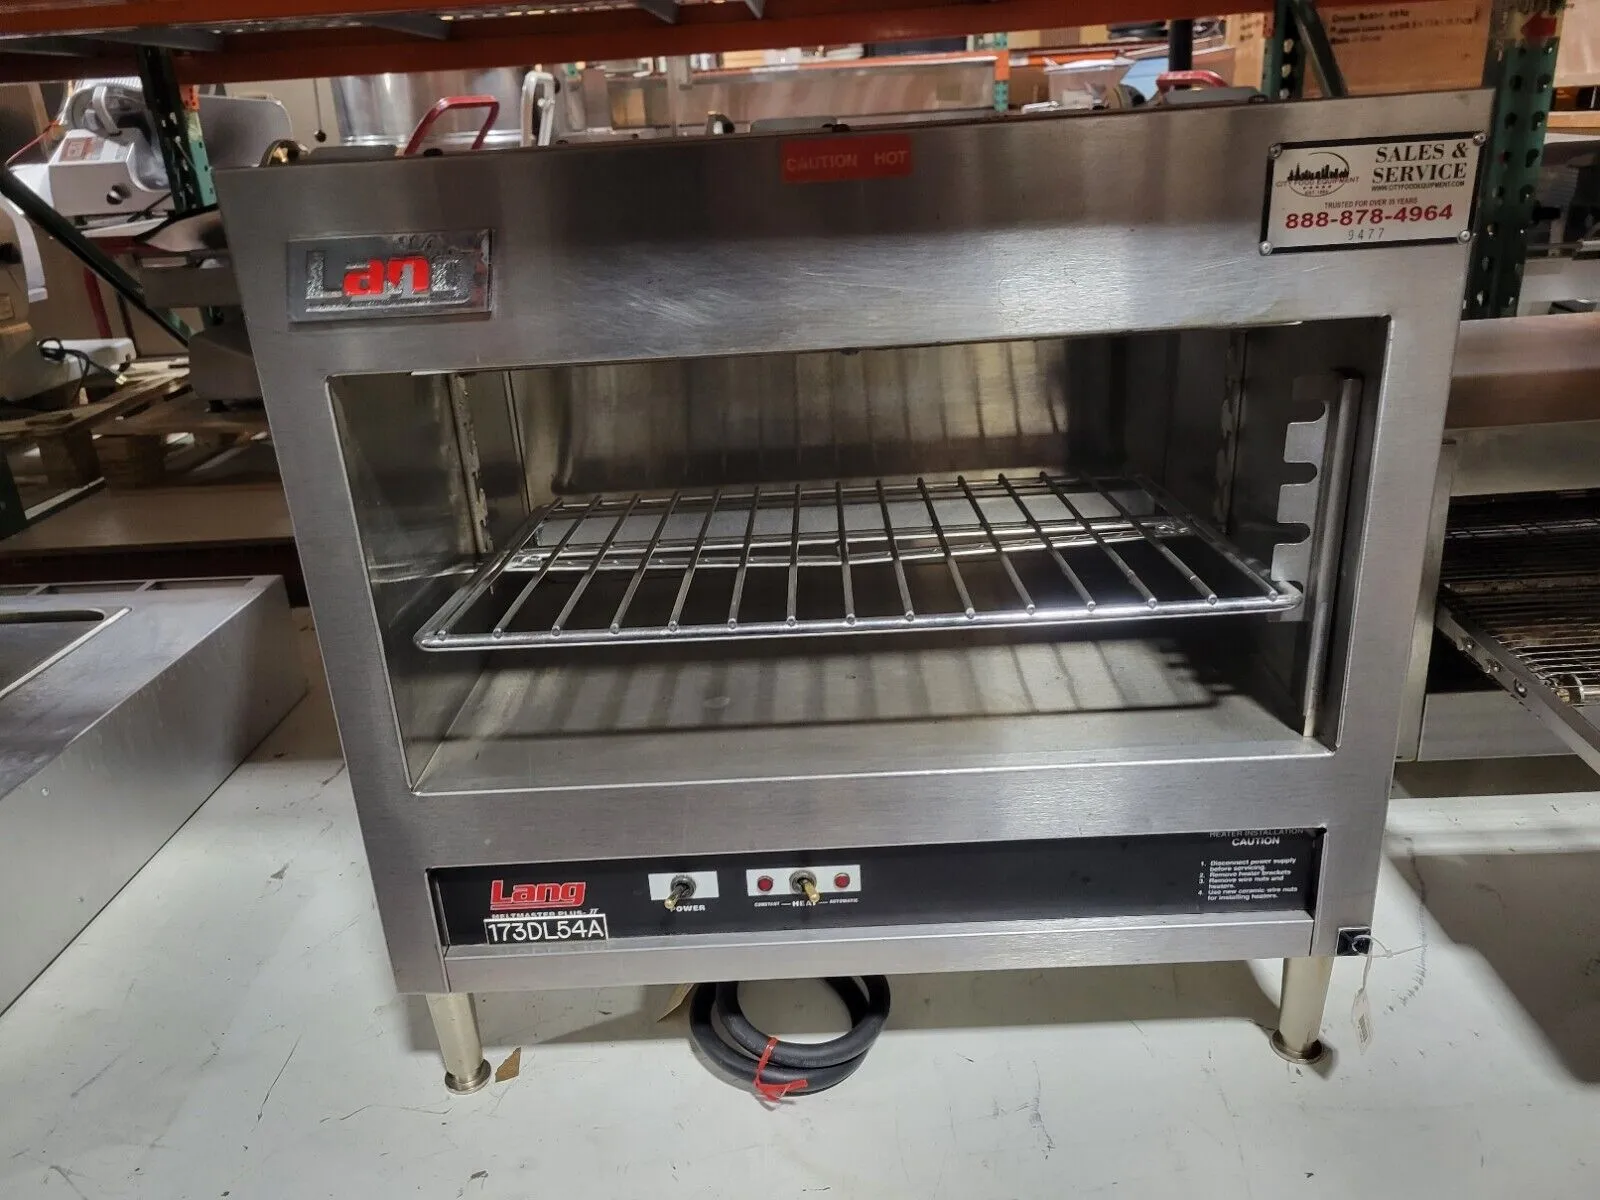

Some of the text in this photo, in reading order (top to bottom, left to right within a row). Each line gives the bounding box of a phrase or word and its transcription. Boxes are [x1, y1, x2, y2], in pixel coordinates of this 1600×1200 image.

[786, 150, 909, 172] CAUTION HOT
[1375, 142, 1468, 163] SALES &
[1372, 162, 1467, 184] SERVICE
[1325, 200, 1353, 209] TRUSTED
[1355, 199, 1368, 207] FOR
[1369, 199, 1388, 207] OVER
[1397, 196, 1418, 205] YEARS
[1285, 204, 1453, 229] 888-878-4964
[1348, 227, 1384, 240] 9477
[1232, 836, 1280, 846] CAUTION
[1210, 859, 1249, 867] Disconnect
[1273, 857, 1297, 865] supply
[490, 879, 587, 910] Lang
[1218, 893, 1250, 902] installing
[669, 903, 706, 912] OWER
[488, 919, 605, 942] 173DL54A
